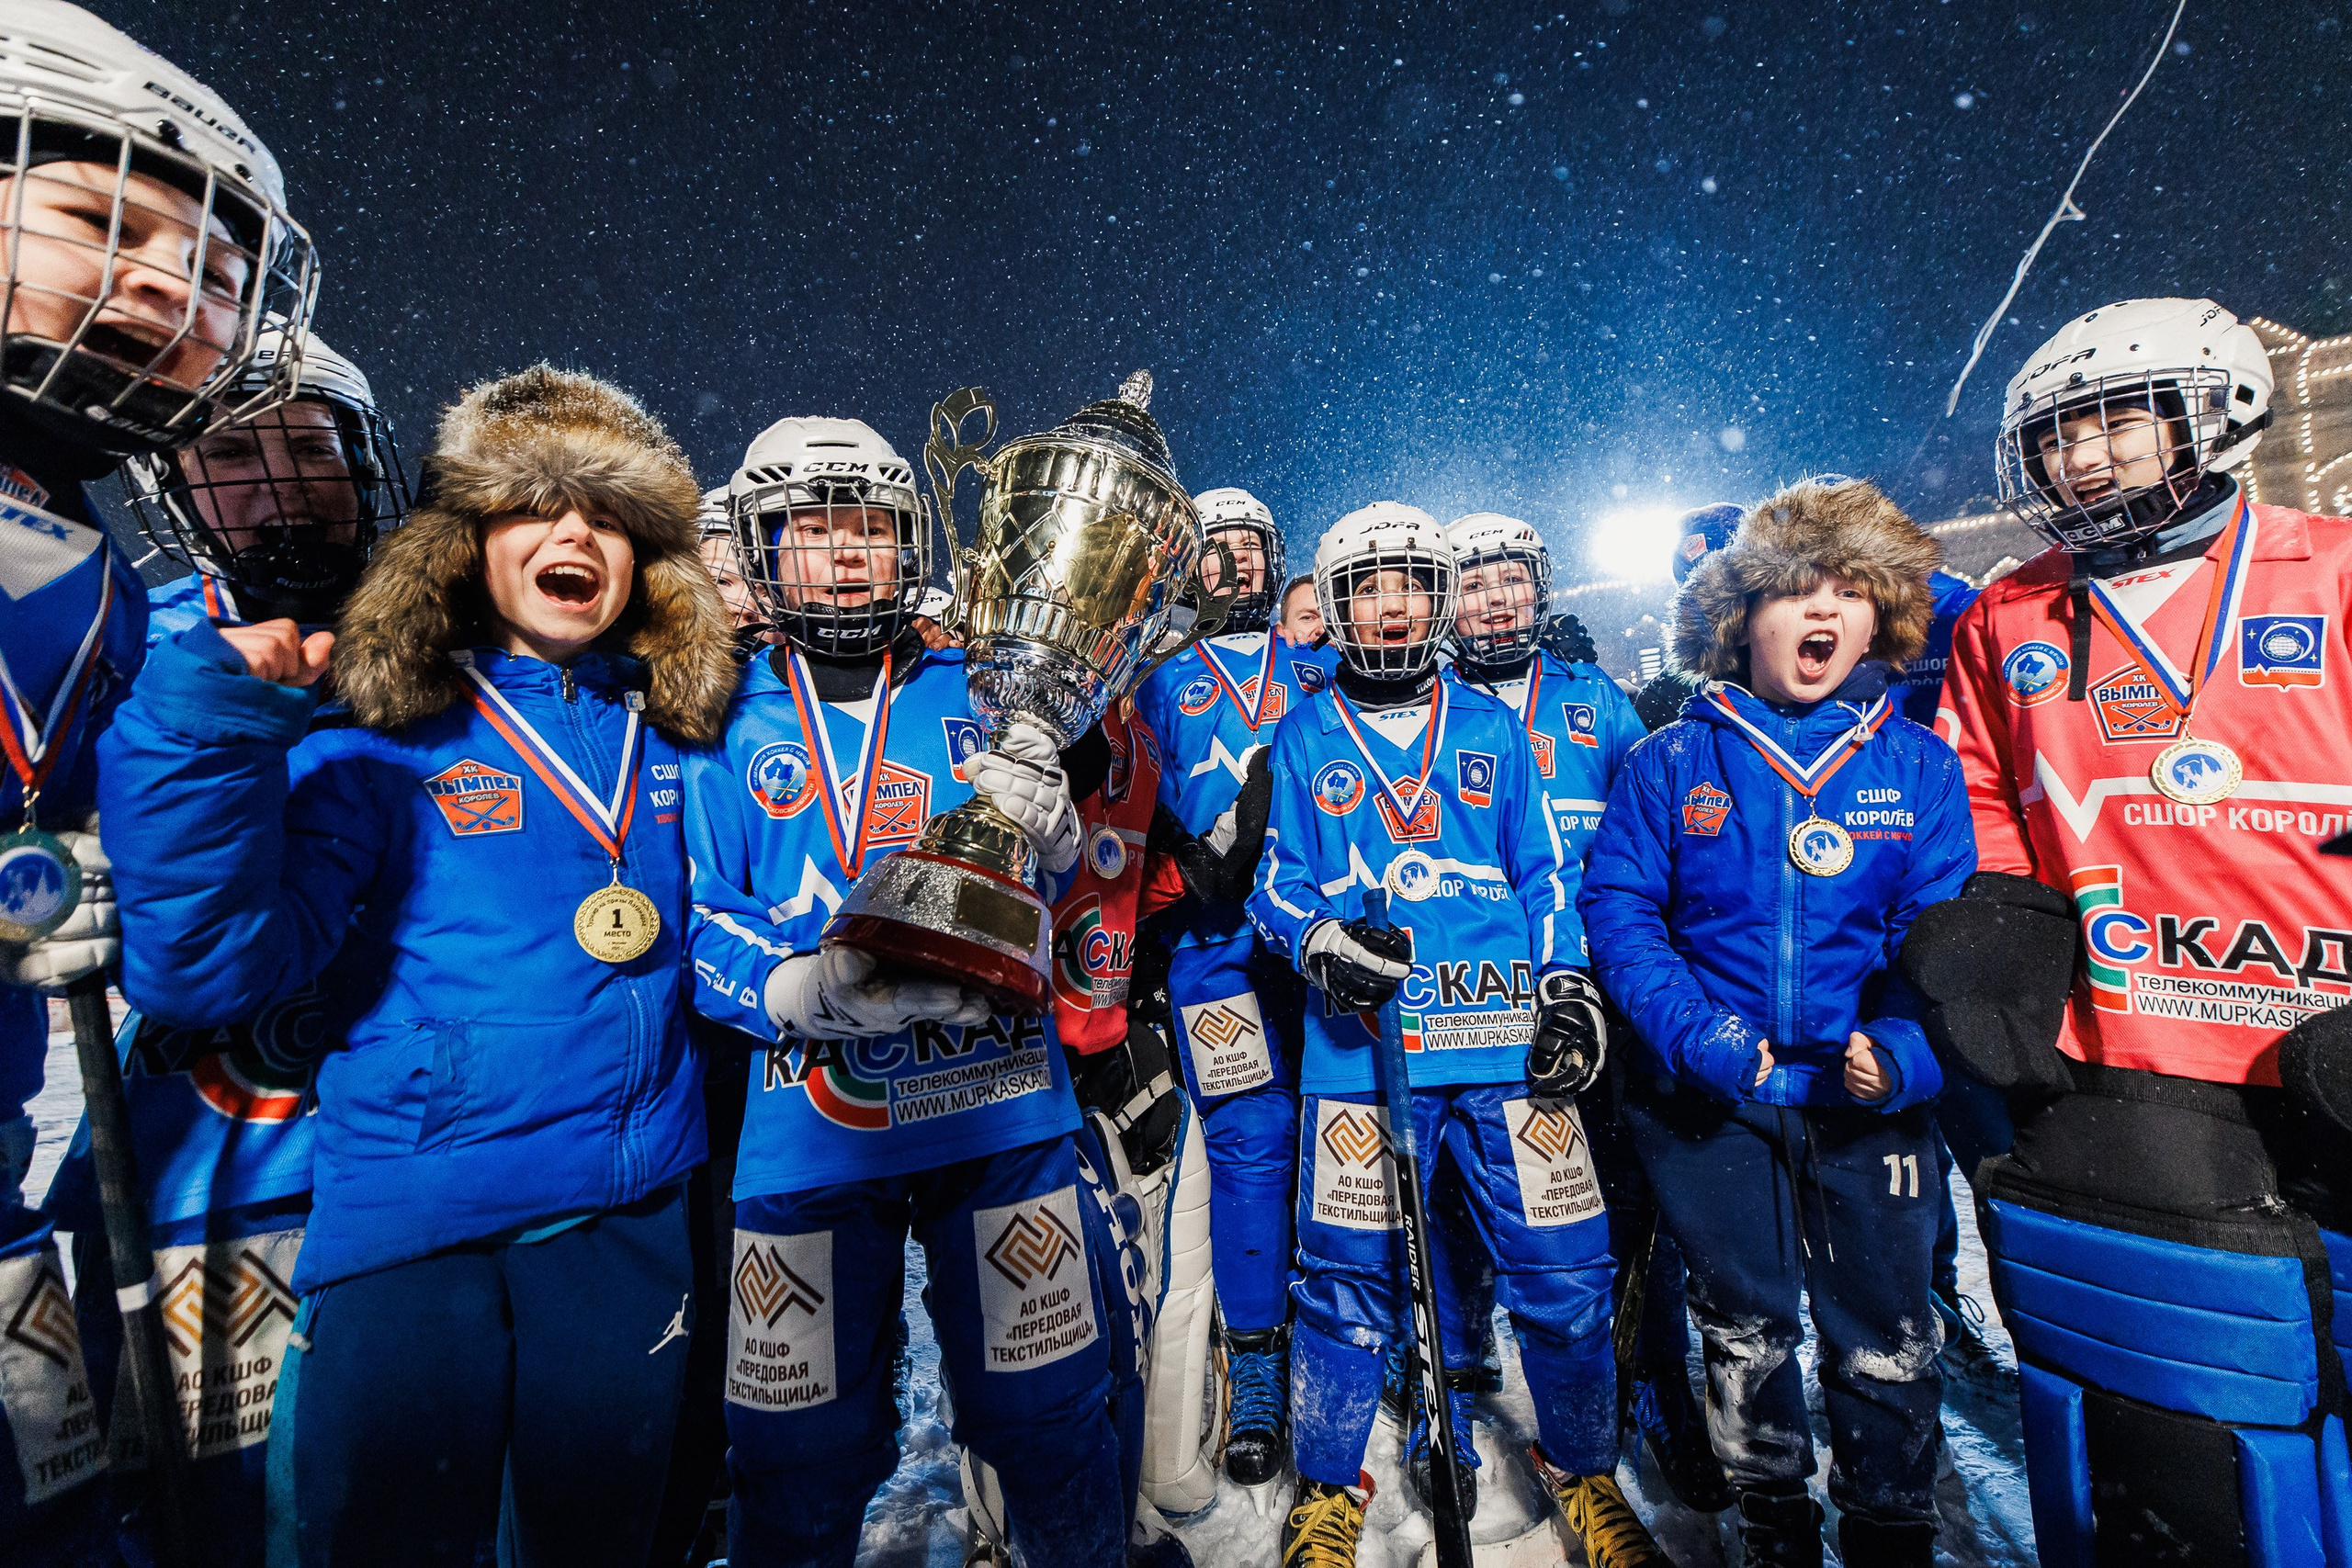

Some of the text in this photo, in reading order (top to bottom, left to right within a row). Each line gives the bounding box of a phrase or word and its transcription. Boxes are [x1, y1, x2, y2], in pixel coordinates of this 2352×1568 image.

[2017, 347, 2097, 389] JOFA
[803, 462, 869, 473] CCM
[1360, 521, 1419, 534] JOFA
[1469, 529, 1504, 539] CCM
[2111, 568, 2177, 590] STEX
[817, 624, 882, 639] CCM
[1379, 710, 1419, 721] STEX
[462, 765, 479, 773] ХК
[428, 776, 518, 795] ВЫМПЕЛ
[458, 793, 500, 804] КОРОЛЕВ
[2124, 803, 2217, 827] СШОР
[1849, 829, 1883, 840] ОККЕЙ
[612, 908, 623, 929] 1
[1207, 1059, 1259, 1078] «ПЕРЕДОВАЯ
[1214, 1052, 1247, 1066] АО КШФ
[1338, 1175, 1383, 1190] АО КШФ
[1550, 1166, 1583, 1183] АО КШФ
[1883, 1154, 1919, 1198] 11
[1328, 1190, 1395, 1207] «ПЕРЕДОВАЯ
[1541, 1179, 1594, 1201] «ПЕРЕДОВАЯ
[1020, 1287, 1070, 1318] АО КШФ
[1006, 1303, 1081, 1341] «ПЕРЕДОВАЯ
[1404, 1213, 1444, 1455] RAIDER STEX
[745, 1337, 790, 1359] АО КШФ
[213, 1357, 272, 1386] КШФ
[736, 1359, 808, 1384] «ПЕРЕДОВАЯ
[729, 1378, 829, 1406] ТЕКСТИЛЬЩИЦА»
